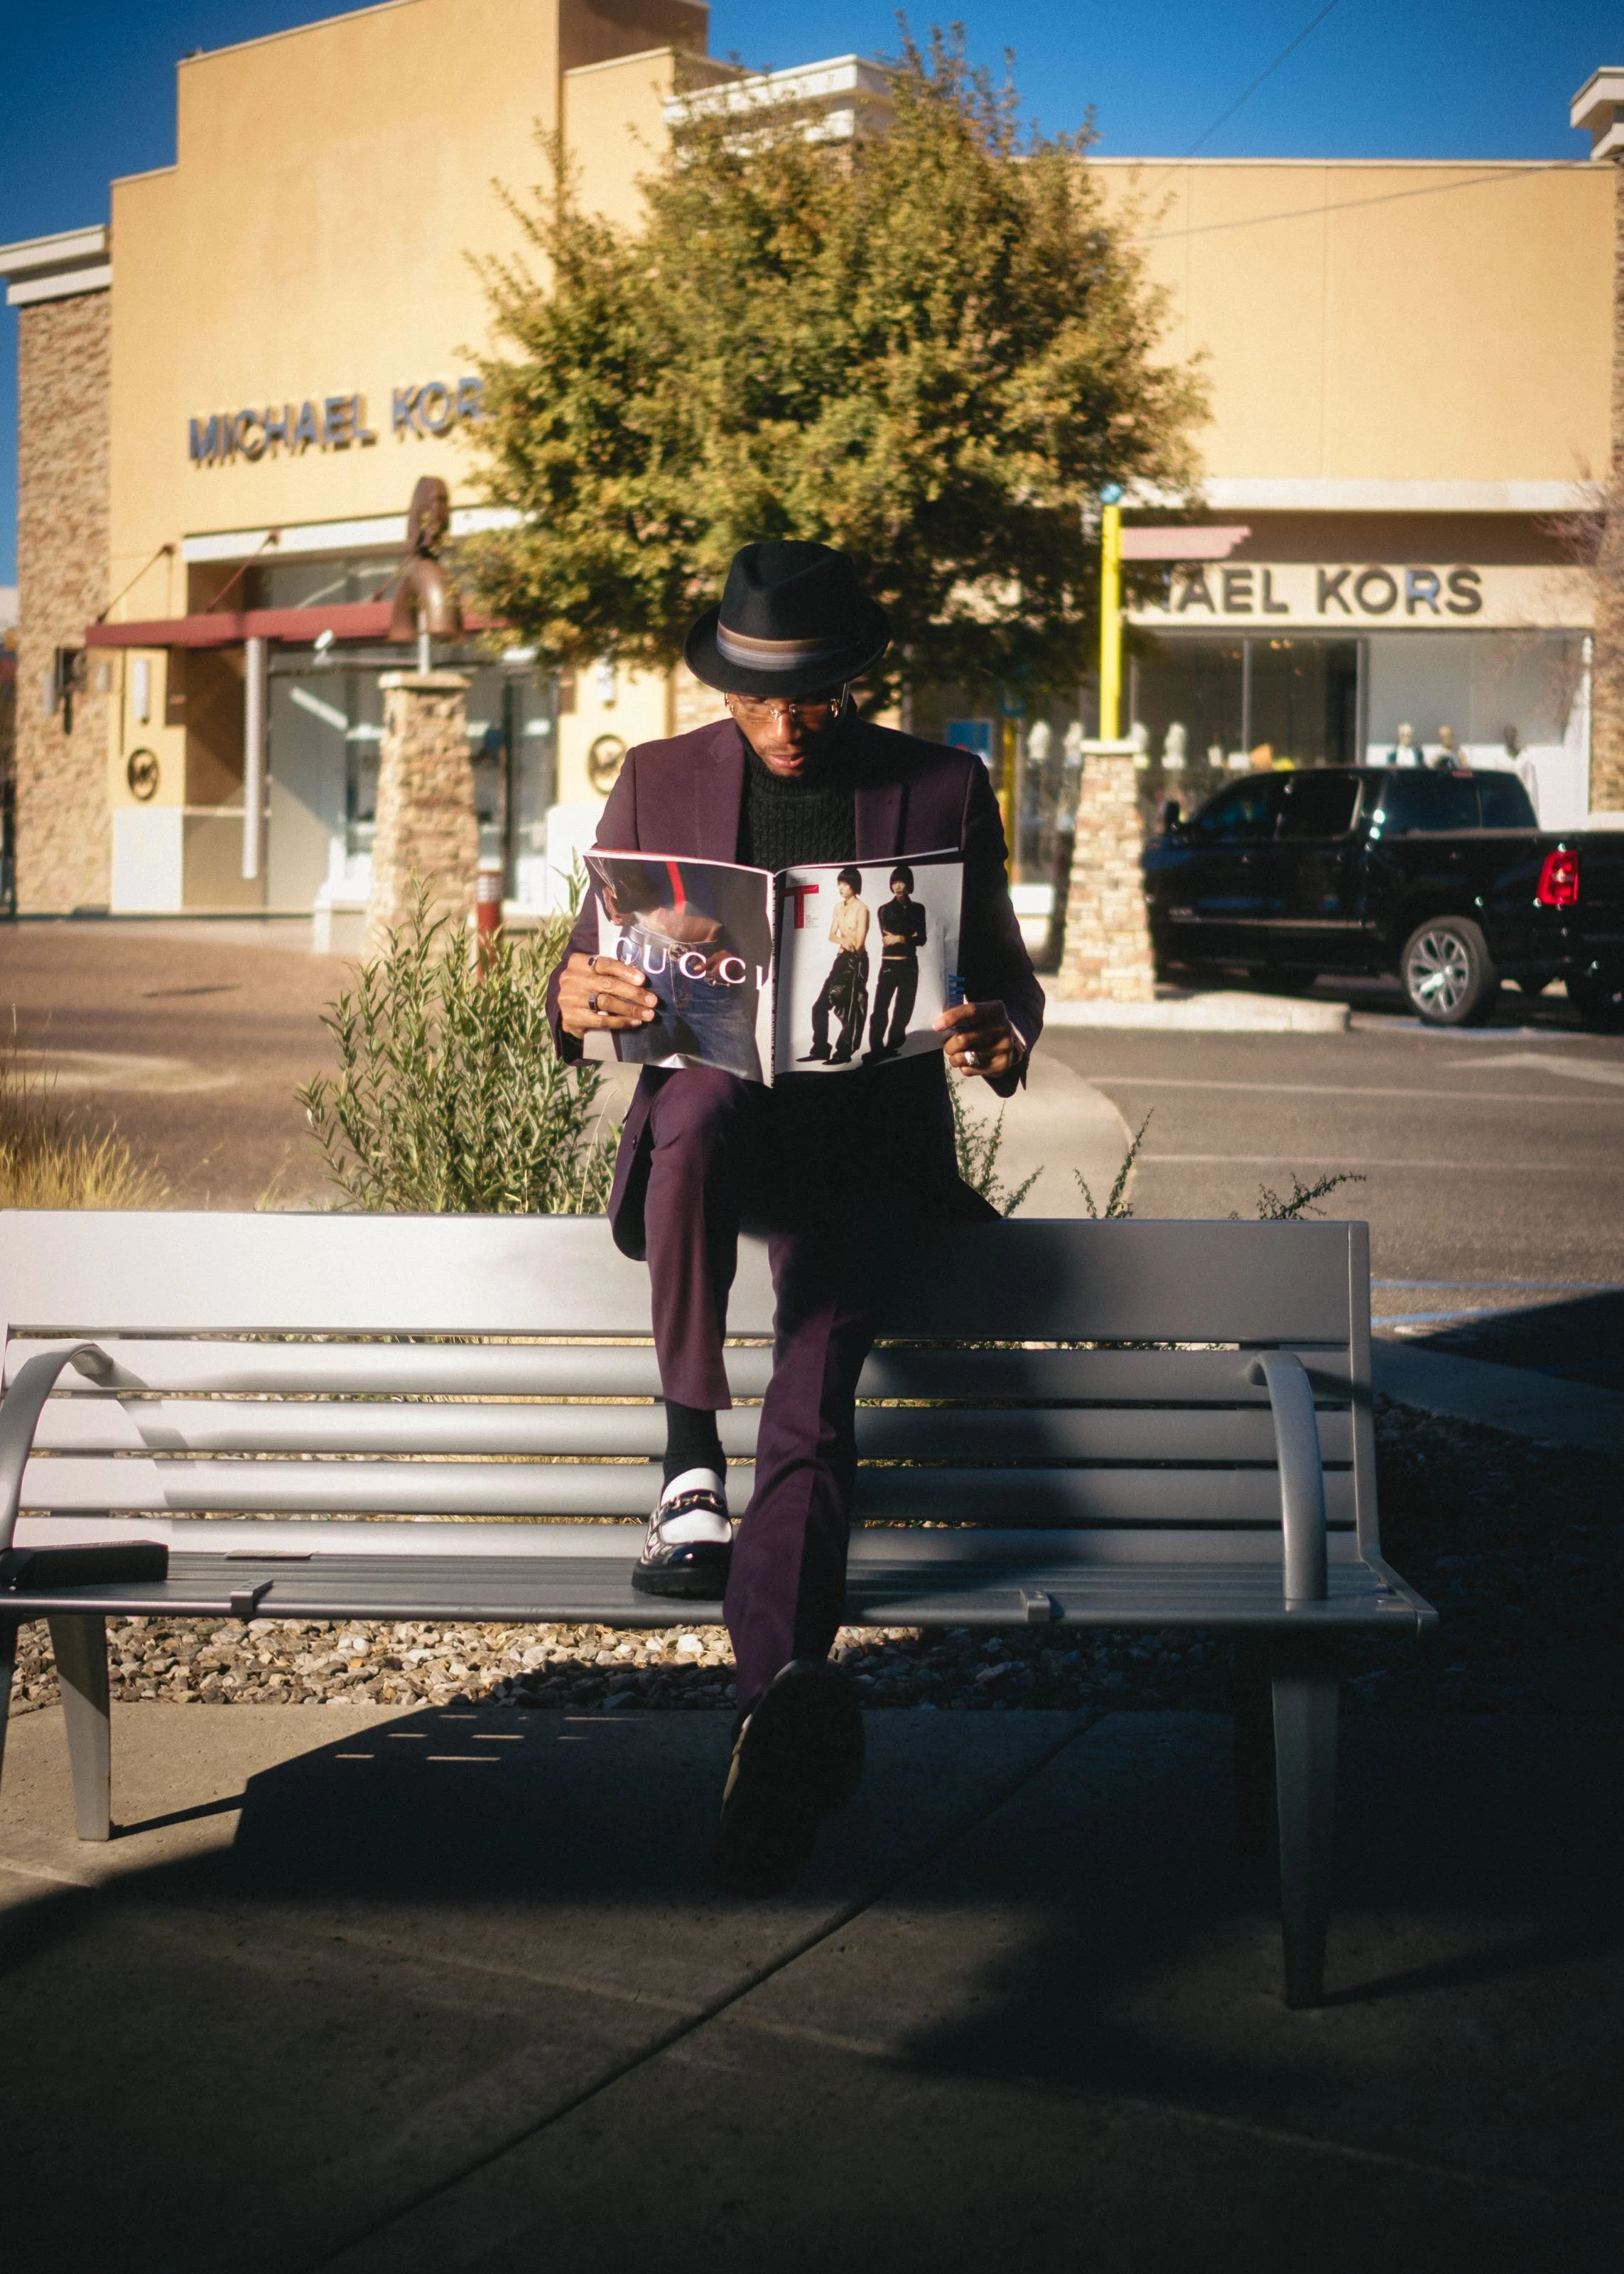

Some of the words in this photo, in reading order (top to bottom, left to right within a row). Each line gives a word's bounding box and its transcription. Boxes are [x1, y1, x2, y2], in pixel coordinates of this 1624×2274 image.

[189, 392, 373, 462] MICHAEL
[392, 377, 499, 433] KOR
[1318, 569, 1483, 615] KORS
[781, 884, 819, 929] T
[615, 937, 763, 991] GUCCI
